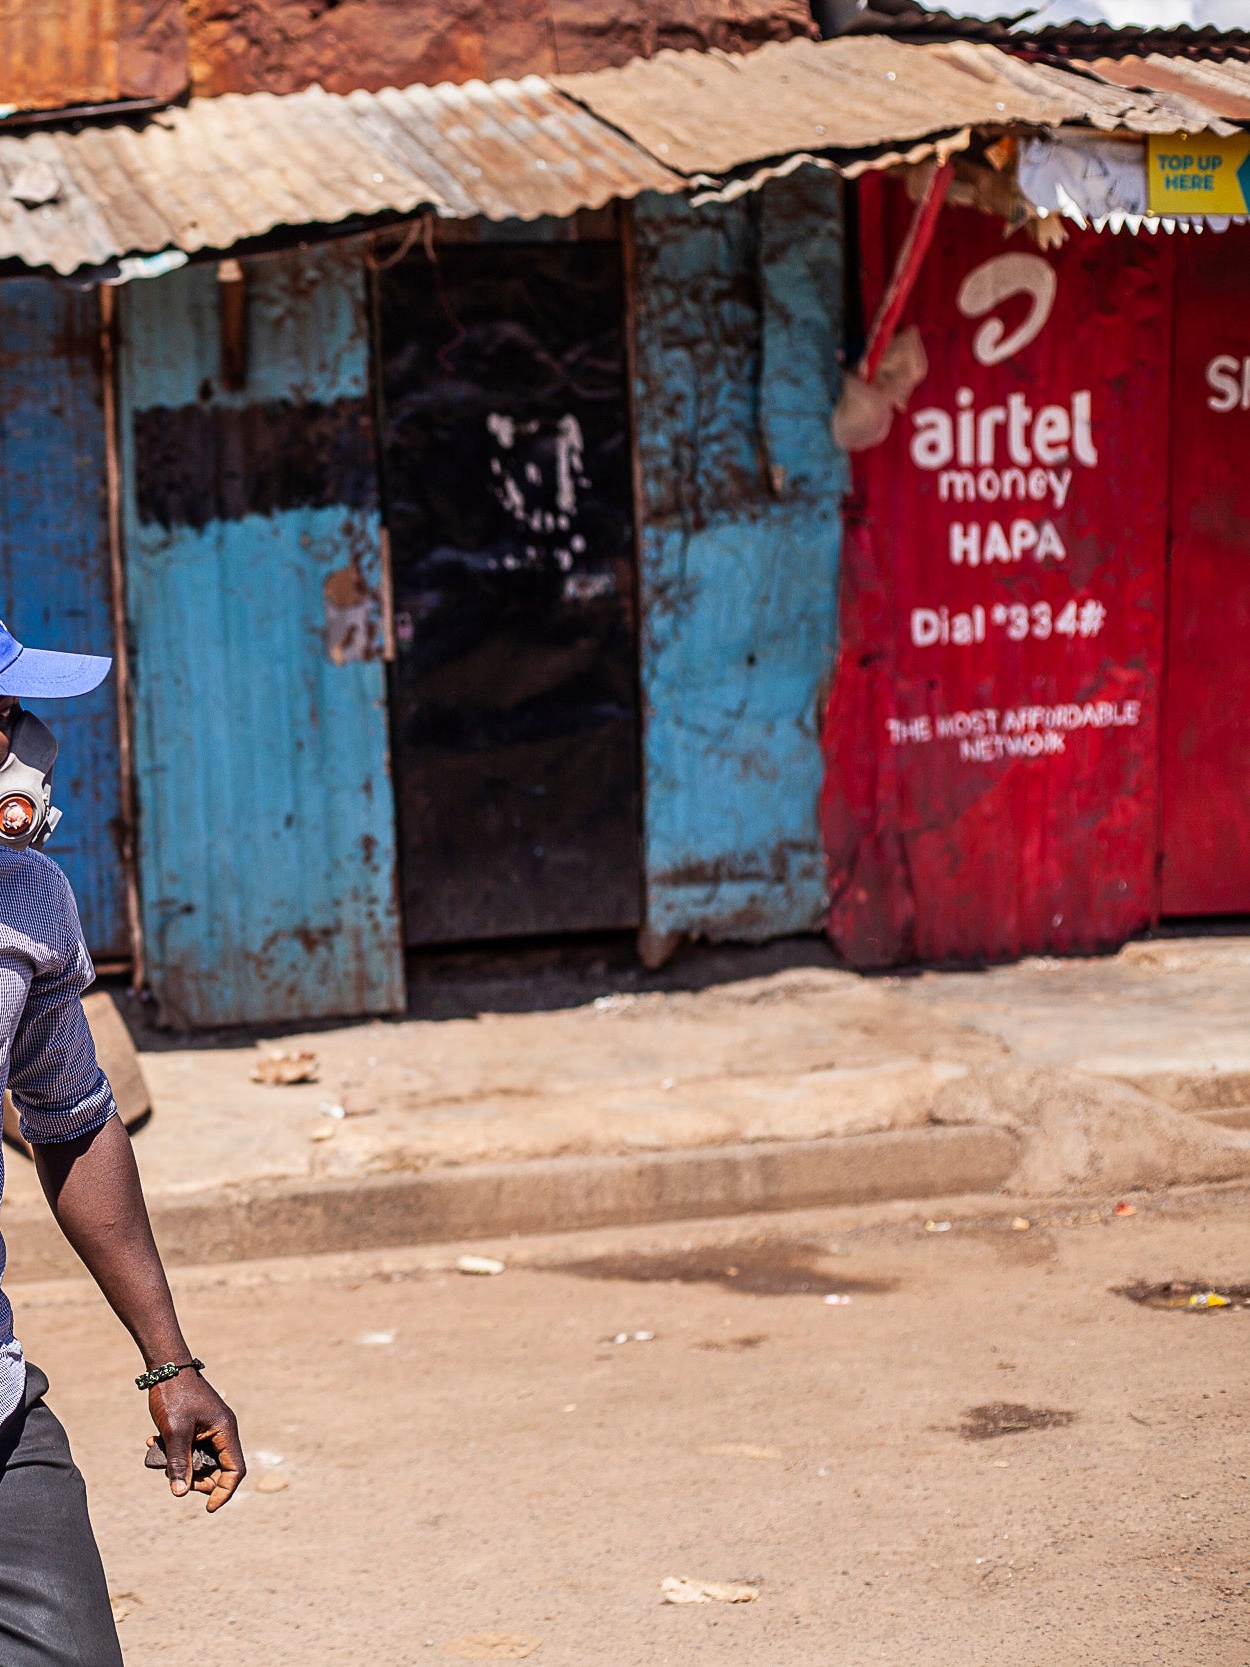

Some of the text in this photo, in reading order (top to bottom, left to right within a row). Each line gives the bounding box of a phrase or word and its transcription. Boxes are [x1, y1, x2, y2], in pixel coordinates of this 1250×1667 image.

[1158, 154, 1222, 171] TOP UP
[1165, 175, 1214, 191] HERE
[910, 387, 1098, 469] airtel
[939, 467, 1072, 509] money
[950, 518, 1066, 567] HAPA
[911, 605, 985, 648] Dial
[885, 701, 1141, 745] THE MOST AFFORDABLE
[959, 731, 1066, 763] NETWORK
